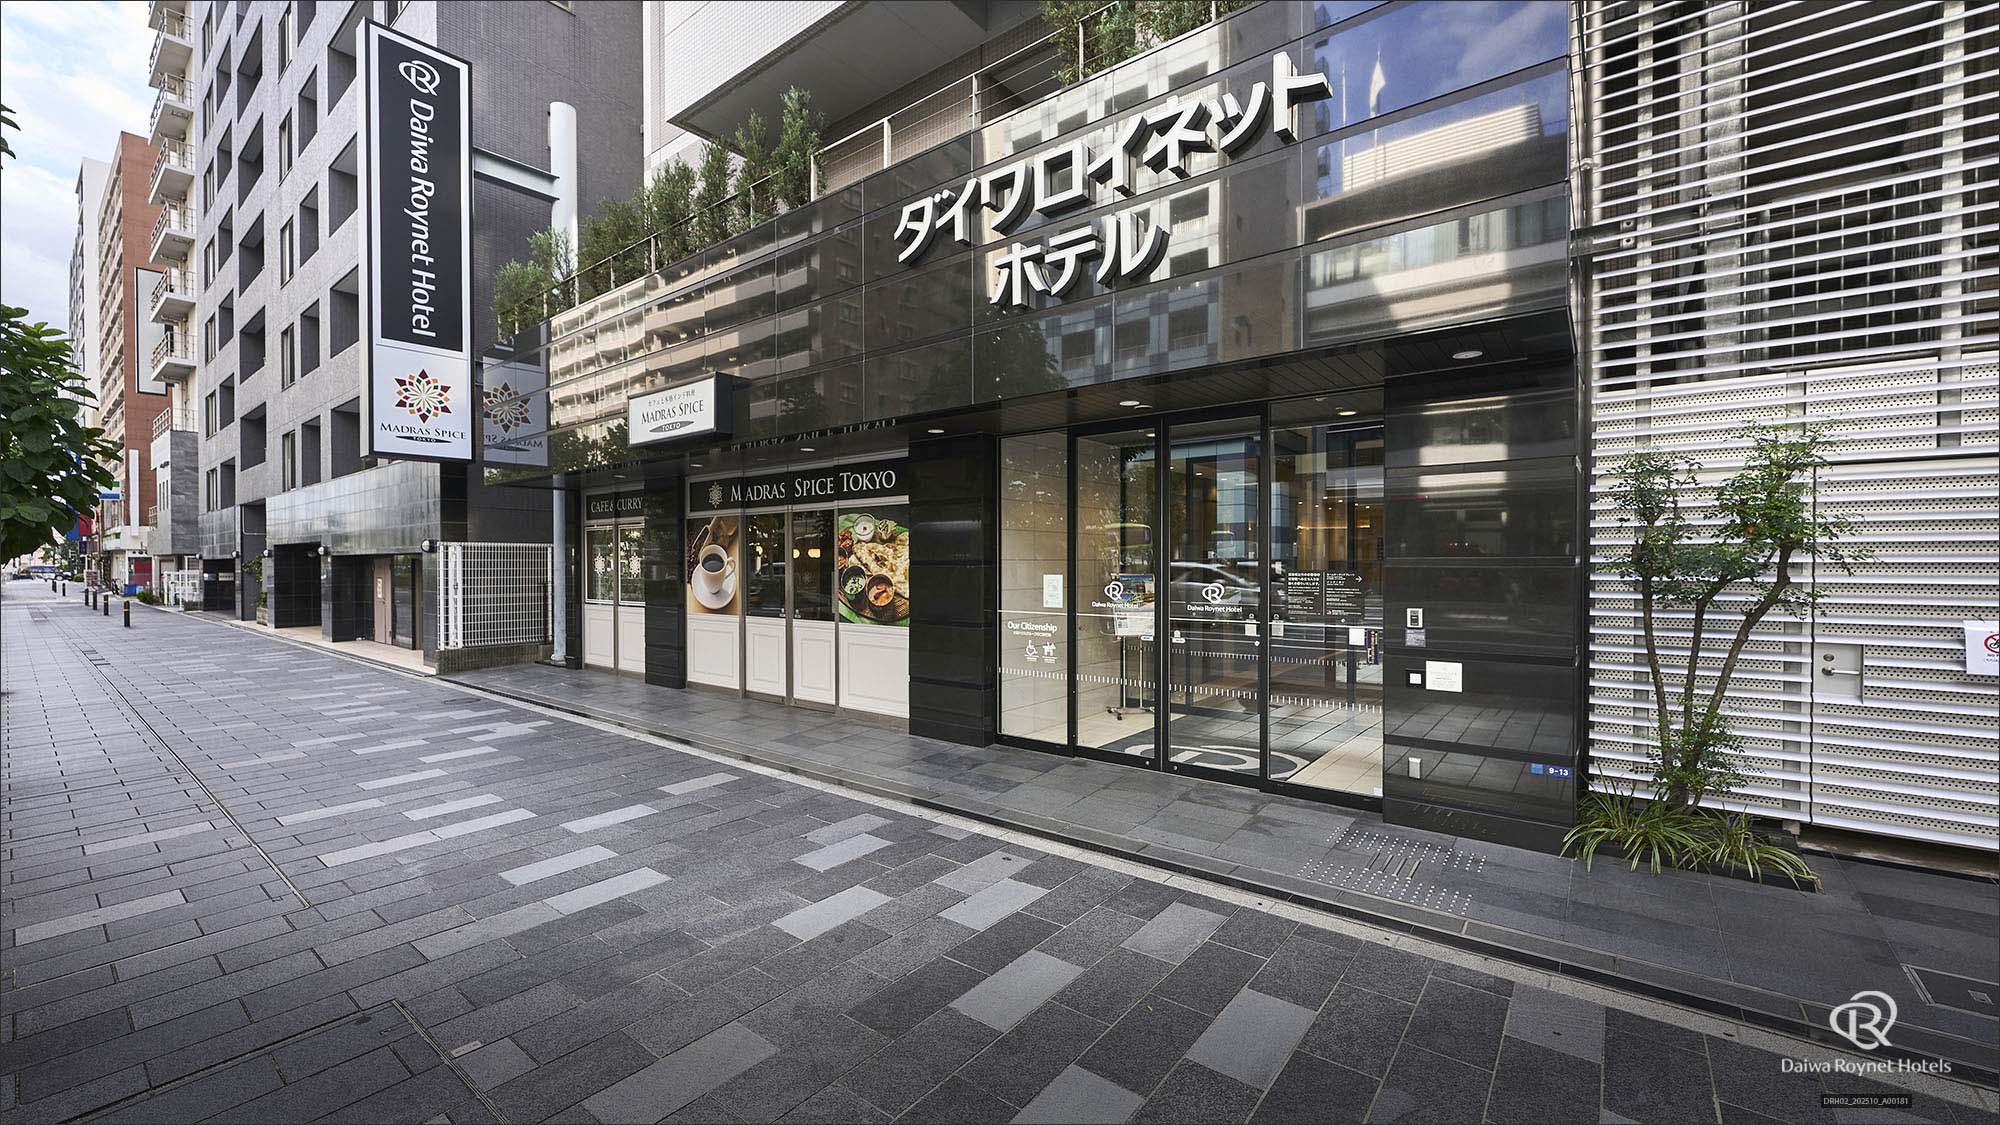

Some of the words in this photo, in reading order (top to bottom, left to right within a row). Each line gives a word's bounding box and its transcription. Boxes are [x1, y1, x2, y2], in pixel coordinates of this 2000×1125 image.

[409, 98, 435, 173] Daiwa
[893, 51, 1333, 265] ダイワロイネット
[404, 175, 436, 267] Roynet
[990, 209, 1171, 309] ホテル
[411, 269, 437, 337] Hotel
[641, 405, 677, 424] MADRAS
[679, 399, 704, 416] SPICE
[380, 422, 431, 436] MADRAS
[434, 427, 467, 440] SPICE
[730, 482, 786, 502] MADRAS
[795, 477, 834, 498] SPICE
[839, 470, 897, 492] TOKYO
[591, 502, 608, 513] CAFE
[617, 498, 643, 512] CURRY
[1187, 604, 1204, 612] Daiwa
[1205, 605, 1225, 613] Roynet
[1008, 621, 1020, 630] Our
[1021, 622, 1057, 633] Citizenship
